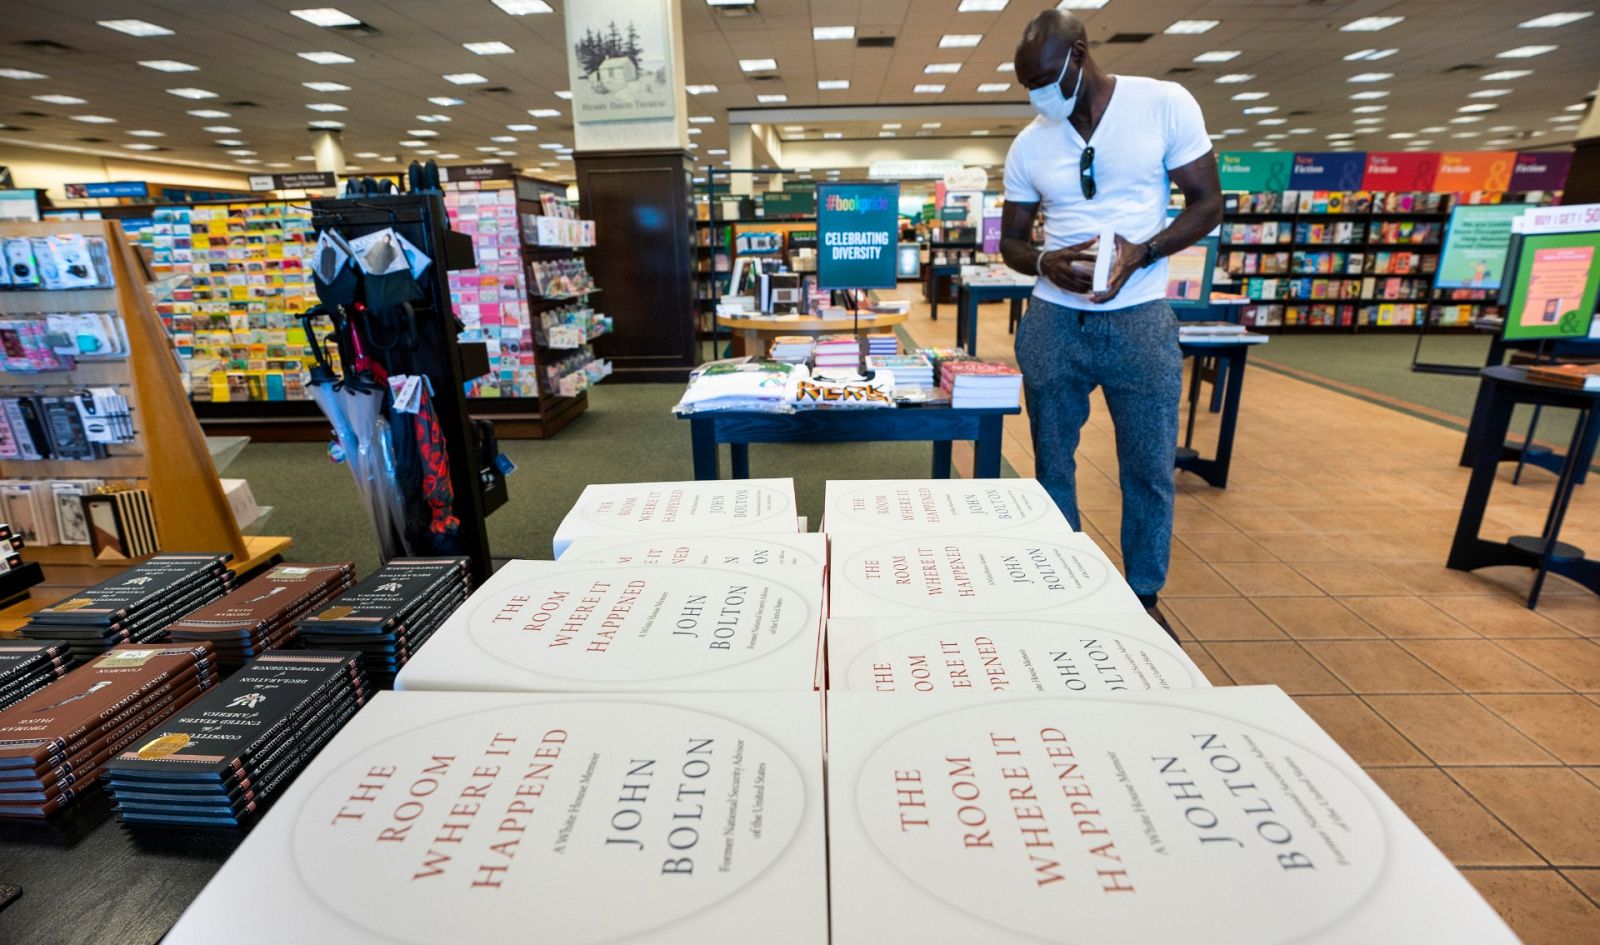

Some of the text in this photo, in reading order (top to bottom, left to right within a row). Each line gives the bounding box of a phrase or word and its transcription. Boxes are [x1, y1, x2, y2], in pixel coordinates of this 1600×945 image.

[1221, 164, 1252, 172] Fiction
[1294, 164, 1325, 174] Fiction
[826, 194, 888, 214] #bookpride
[824, 231, 889, 246] CELEBRATING
[832, 246, 882, 260] DIVERSITY
[864, 559, 881, 580] THE
[892, 555, 912, 585] ROOM
[918, 547, 944, 596] WHERE IT
[944, 545, 976, 598] HAPPENED
[1000, 554, 1035, 585] JOHN
[1026, 548, 1066, 592] BOLTON
[492, 593, 531, 624] THE
[522, 590, 570, 632] ROOM
[549, 580, 612, 649] WHERE IT
[586, 579, 646, 654] HAPPENED
[672, 594, 708, 639] JOHN
[709, 584, 750, 651] BOLTON
[15, 653, 42, 671] AMERICA
[23, 672, 50, 690] AMERICA
[908, 654, 934, 692] OOM
[940, 640, 972, 690] ERE IT
[974, 636, 1010, 692] PENED
[1049, 650, 1087, 691] OHN
[1079, 638, 1128, 691] LTON
[99, 670, 168, 719] COMMON SENSE
[100, 683, 171, 732] COMMON SENSE
[105, 694, 173, 744] COMMON SENSE
[249, 716, 288, 750] CONSTITUTION
[293, 695, 312, 713] UNITED
[327, 666, 346, 684] AMERICA
[254, 725, 291, 760] CONSTITUTION
[259, 735, 295, 770] CONSTITUTION
[300, 714, 318, 732] UNITED
[332, 684, 351, 703] AMERICA
[331, 765, 397, 826] THE
[376, 754, 456, 842] ROOM
[412, 732, 518, 880] WHERE IT
[604, 758, 656, 851] JOHN
[727, 767, 742, 797] Security
[894, 768, 930, 832] THE
[944, 756, 995, 850] ROOM
[1150, 754, 1244, 848] JOHN
[1190, 733, 1316, 871] BOLTON
[470, 729, 568, 889] HAPPENED
[556, 812, 576, 846] White
[567, 782, 587, 814] House
[660, 738, 714, 876] BOLTON
[723, 799, 738, 834] National
[990, 732, 1066, 888] WHERE IT
[1040, 727, 1136, 894] HAPPENED
[718, 837, 734, 871] Former
